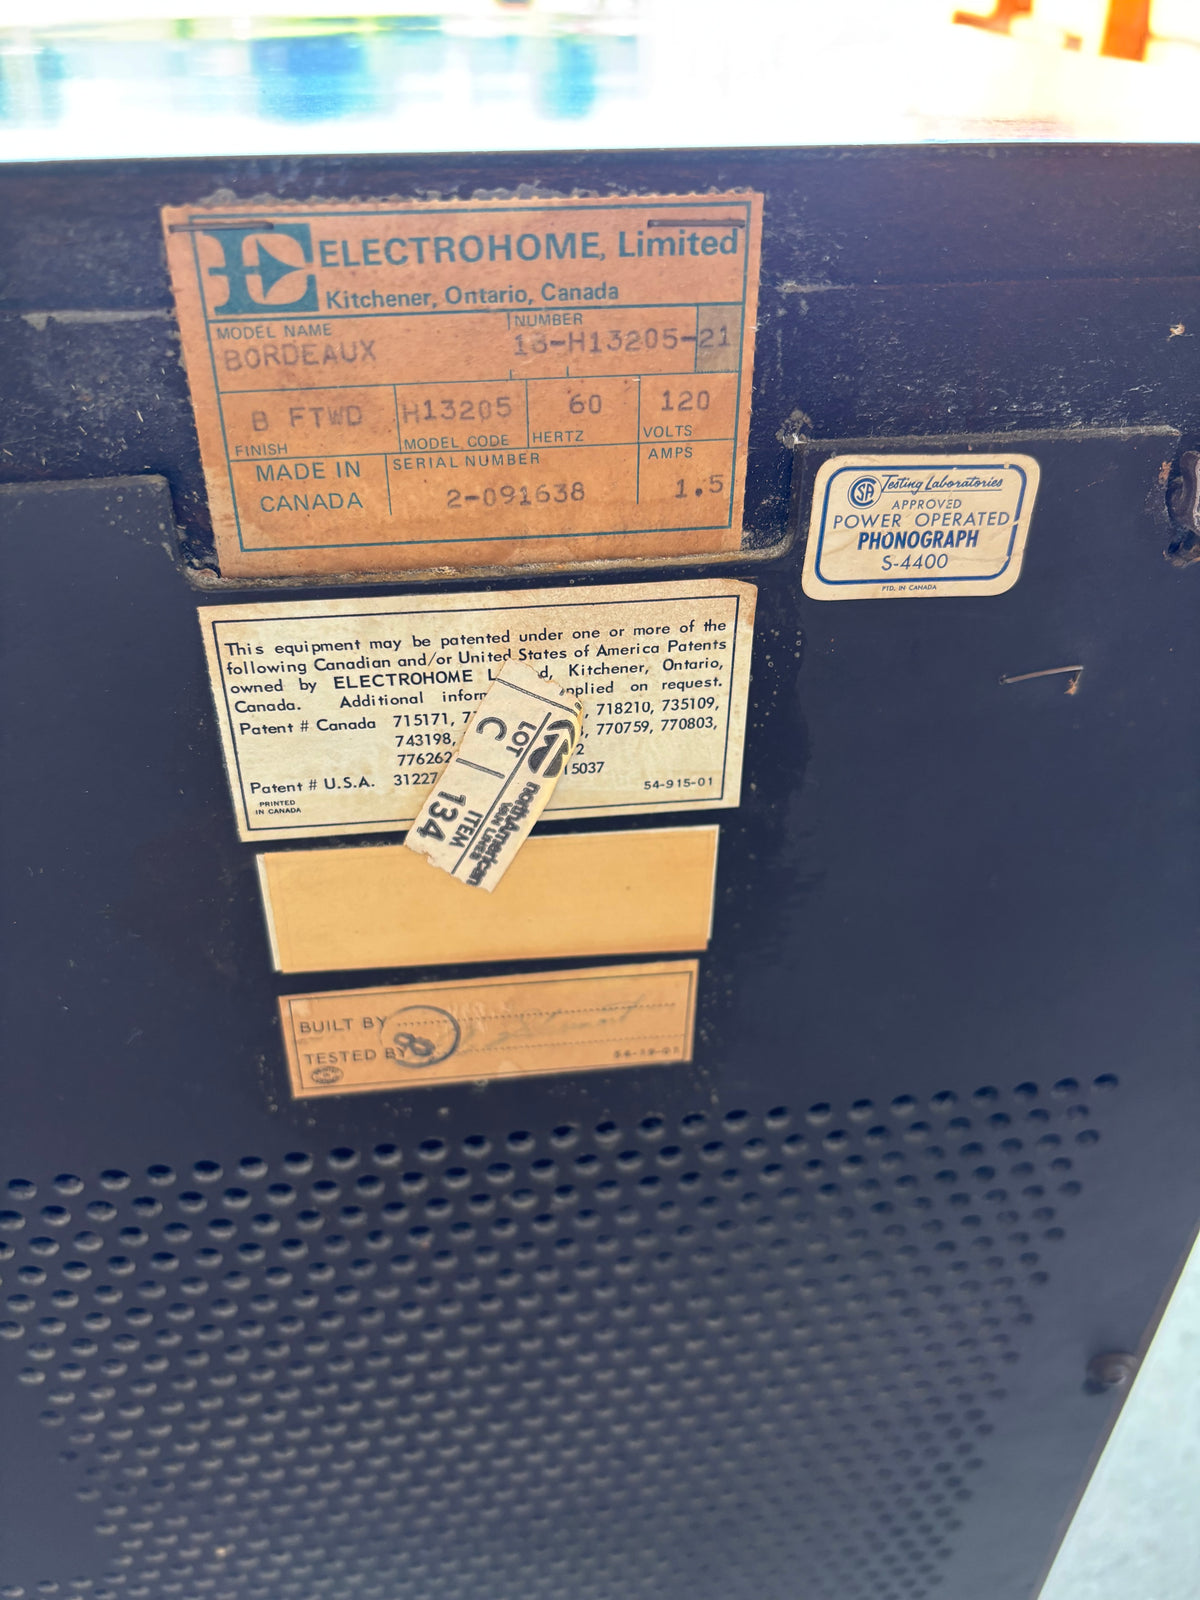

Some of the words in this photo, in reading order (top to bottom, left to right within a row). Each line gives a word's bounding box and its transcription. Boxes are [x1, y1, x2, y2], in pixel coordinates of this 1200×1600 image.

[318, 231, 606, 268] ELECTROHOME,
[618, 227, 738, 259] Limited
[326, 288, 438, 311] Kitchener,
[444, 284, 534, 306] Ontario,
[540, 281, 619, 302] Canada
[216, 325, 276, 341] MODEL
[284, 323, 333, 338] NAME
[514, 313, 583, 328] NUMBER
[223, 339, 378, 372] BORDEAUX
[402, 396, 512, 425] H13205
[568, 393, 602, 416] 60
[661, 390, 711, 412] 120
[252, 410, 269, 432] B
[289, 405, 364, 429] FTWD
[404, 437, 460, 450] MODEL
[467, 434, 510, 448] CODE
[532, 430, 585, 444] HERTZ
[643, 424, 693, 438] VOLTS
[235, 443, 288, 457] FINISH
[392, 456, 460, 471] SERIAL
[464, 452, 541, 467] NUMBER
[648, 446, 694, 460] AMPS
[256, 462, 326, 483] MADE
[336, 460, 361, 479] IN
[446, 482, 586, 509] 2-091638
[675, 474, 724, 499] 1.5
[881, 474, 924, 495] Testing
[925, 474, 1004, 491] Laboratories
[259, 491, 364, 513] CANADA
[891, 499, 962, 510] APPROVED
[833, 514, 902, 529] POWER
[915, 511, 1010, 527] OPERATED
[857, 529, 980, 550] PHONOGRAPH
[881, 553, 949, 571] S-4400
[224, 642, 264, 656] This
[275, 640, 361, 657] equipment
[369, 639, 402, 651] may
[412, 635, 431, 647] be
[441, 629, 510, 649] patented
[519, 627, 563, 641] under
[572, 629, 600, 639] one
[609, 628, 624, 637] or
[633, 625, 670, 636] more
[680, 619, 695, 633] of
[704, 618, 726, 632] the
[227, 660, 307, 675] following
[314, 655, 391, 672] Canadian
[398, 651, 452, 667] and/or
[458, 648, 511, 664] United
[518, 648, 567, 661] States
[574, 644, 590, 658] of
[596, 643, 660, 657] America
[667, 639, 727, 653] Patents
[230, 678, 283, 694] owned
[298, 677, 317, 693] by
[333, 669, 473, 690] ELECTROHOME
[569, 662, 649, 676] Kitchener,
[662, 657, 724, 671] Ontario,
[234, 698, 301, 713] Canada.
[340, 691, 423, 709] Additional
[630, 684, 648, 692] on
[661, 677, 722, 692] request.
[239, 721, 294, 736] Patent
[300, 720, 309, 732] #
[316, 716, 377, 731] Canada
[392, 711, 455, 728] 715171,
[596, 701, 654, 716] 718210,
[661, 696, 719, 712] 735109,
[395, 732, 456, 748] 743198,
[596, 720, 654, 735] 770759,
[660, 716, 717, 732] 770803,
[475, 716, 508, 741] C
[506, 720, 537, 757] LOT
[250, 781, 303, 795] Patent
[309, 779, 318, 791] #
[324, 776, 375, 791] U.S.A.
[393, 771, 439, 787] 31227
[643, 777, 713, 790] 54-915-01
[417, 790, 467, 841] 134
[449, 810, 484, 848] ITEM
[300, 1018, 353, 1033] BUILT
[363, 1016, 387, 1029] BY
[304, 1049, 377, 1065] TESTED
[385, 1047, 406, 1060] BY
